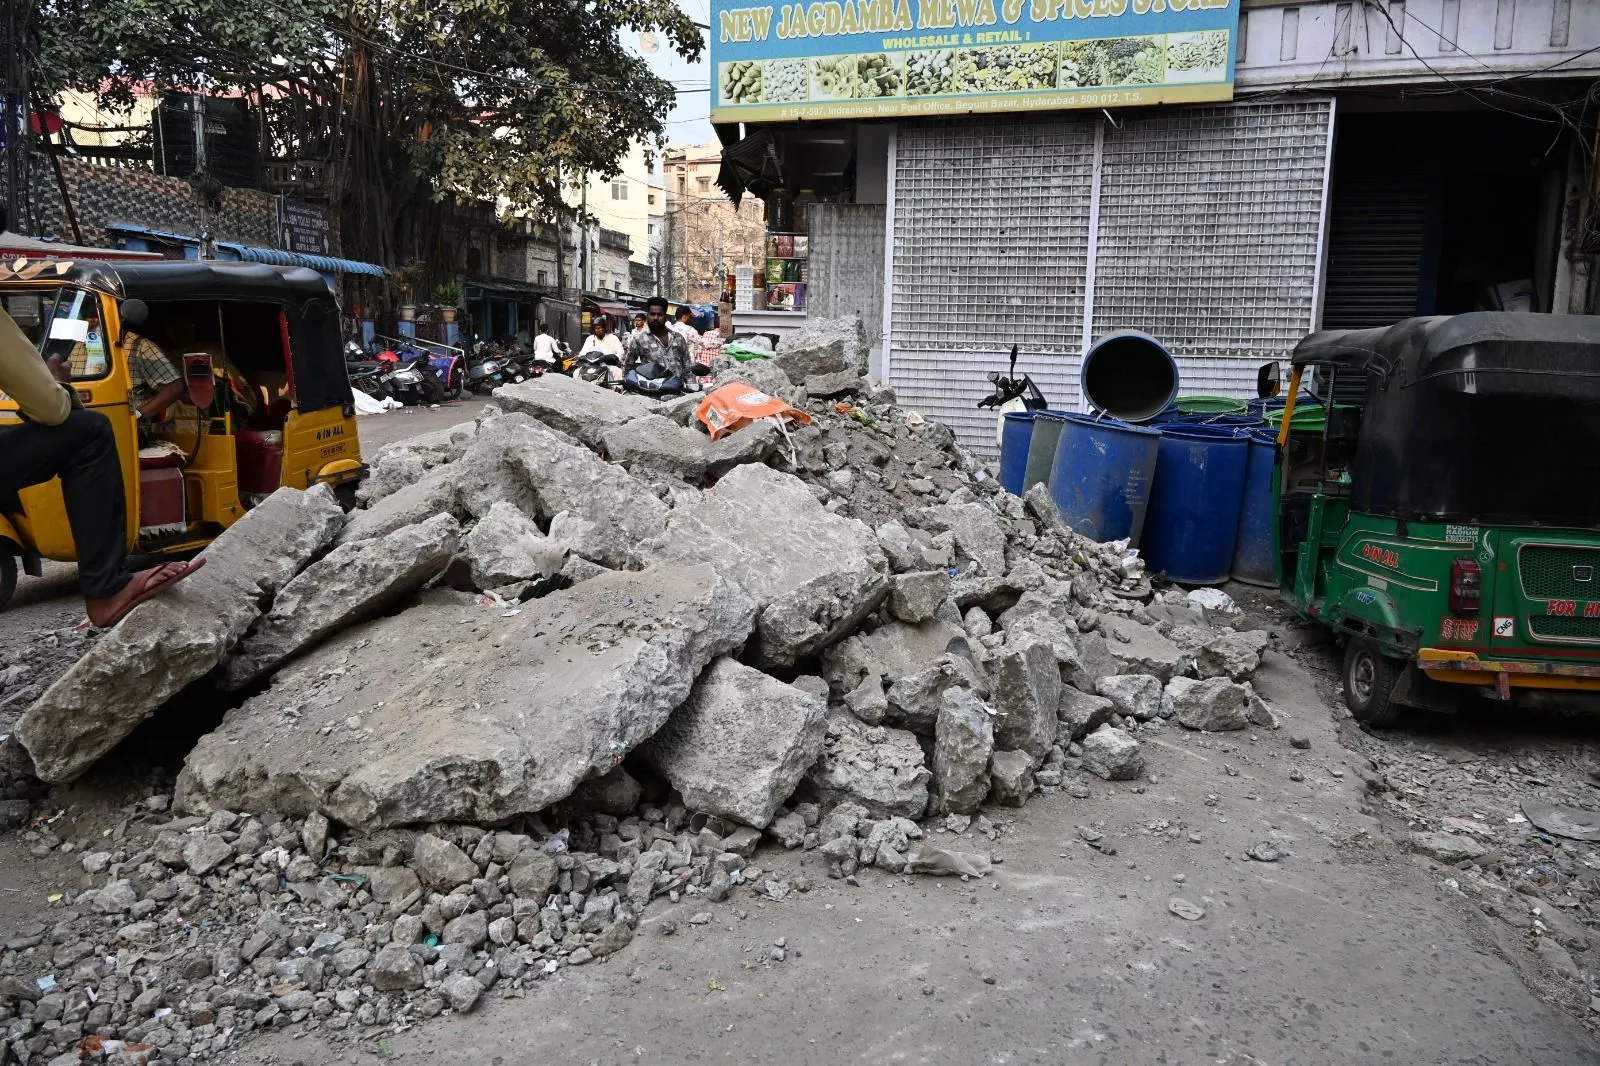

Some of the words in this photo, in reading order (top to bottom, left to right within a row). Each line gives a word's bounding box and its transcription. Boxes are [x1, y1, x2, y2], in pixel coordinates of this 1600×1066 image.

[720, 6, 773, 43] NEW
[776, 0, 913, 39] JAGDAMBA
[917, 0, 998, 29] MEWA
[882, 34, 959, 49] WHOLESALE
[963, 31, 973, 44] &
[976, 30, 1022, 43] RETAIL
[878, 104, 899, 114] Near
[901, 103, 921, 113] Post
[956, 100, 988, 111] Begum
[1081, 95, 1098, 104] 500
[316, 431, 321, 441] 4
[323, 428, 330, 439] IN
[333, 424, 344, 436] ALL
[1370, 545, 1382, 562] IN
[1382, 549, 1399, 568] ALL
[1547, 600, 1576, 616] FOR
[1441, 618, 1478, 641] STOP
[1496, 619, 1513, 635] CNG
